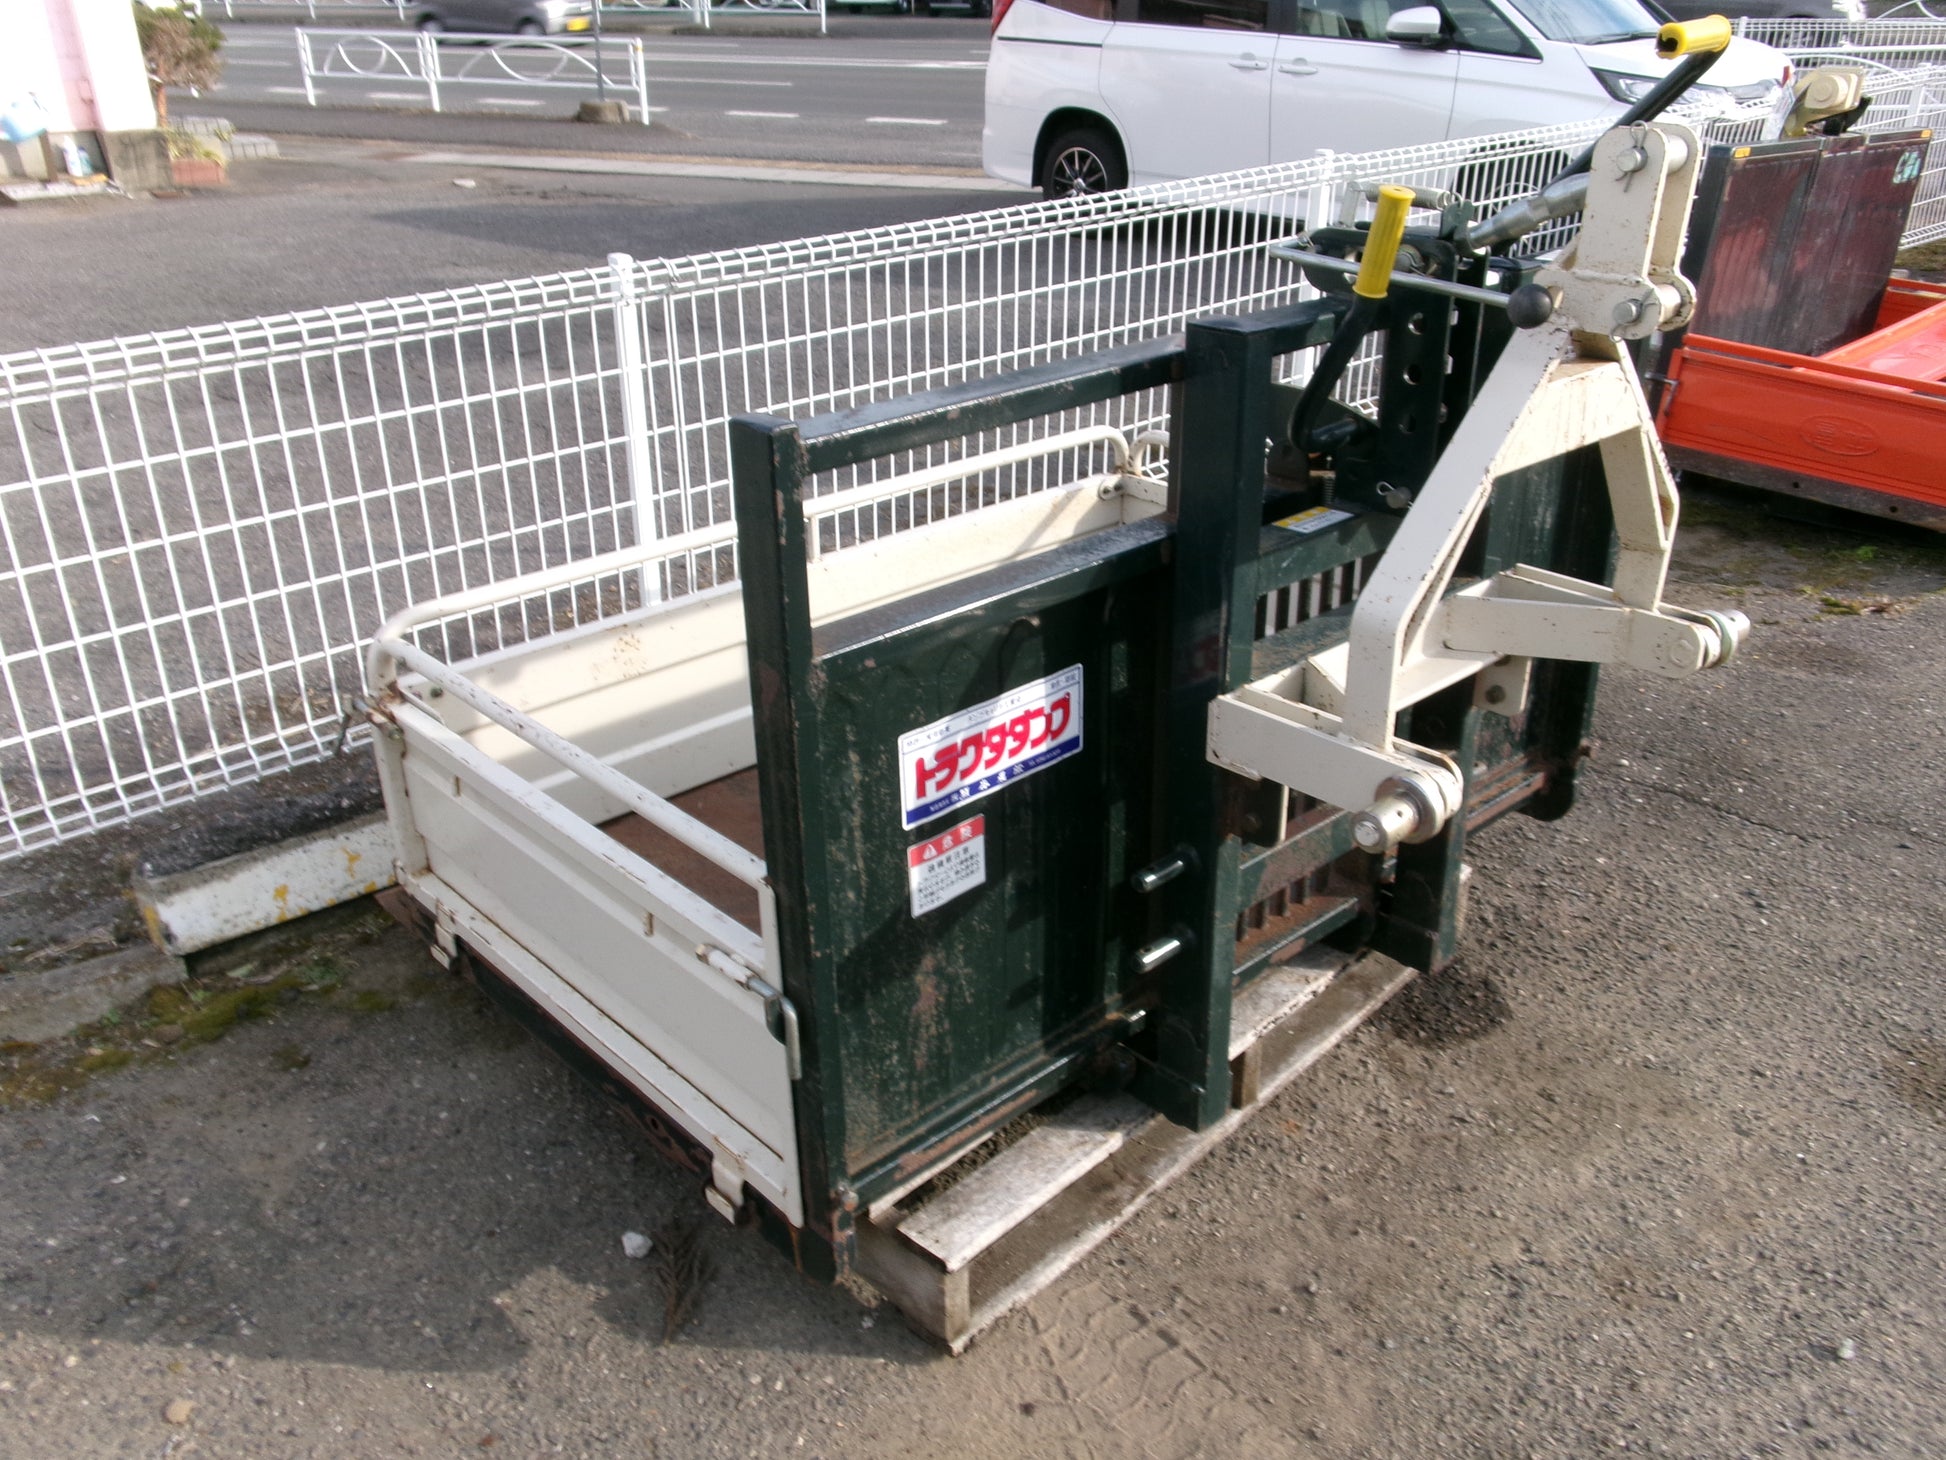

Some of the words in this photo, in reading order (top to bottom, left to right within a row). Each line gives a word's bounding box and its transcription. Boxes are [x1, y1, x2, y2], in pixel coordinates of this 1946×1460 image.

[915, 691, 1071, 799] トラクタダンプ
